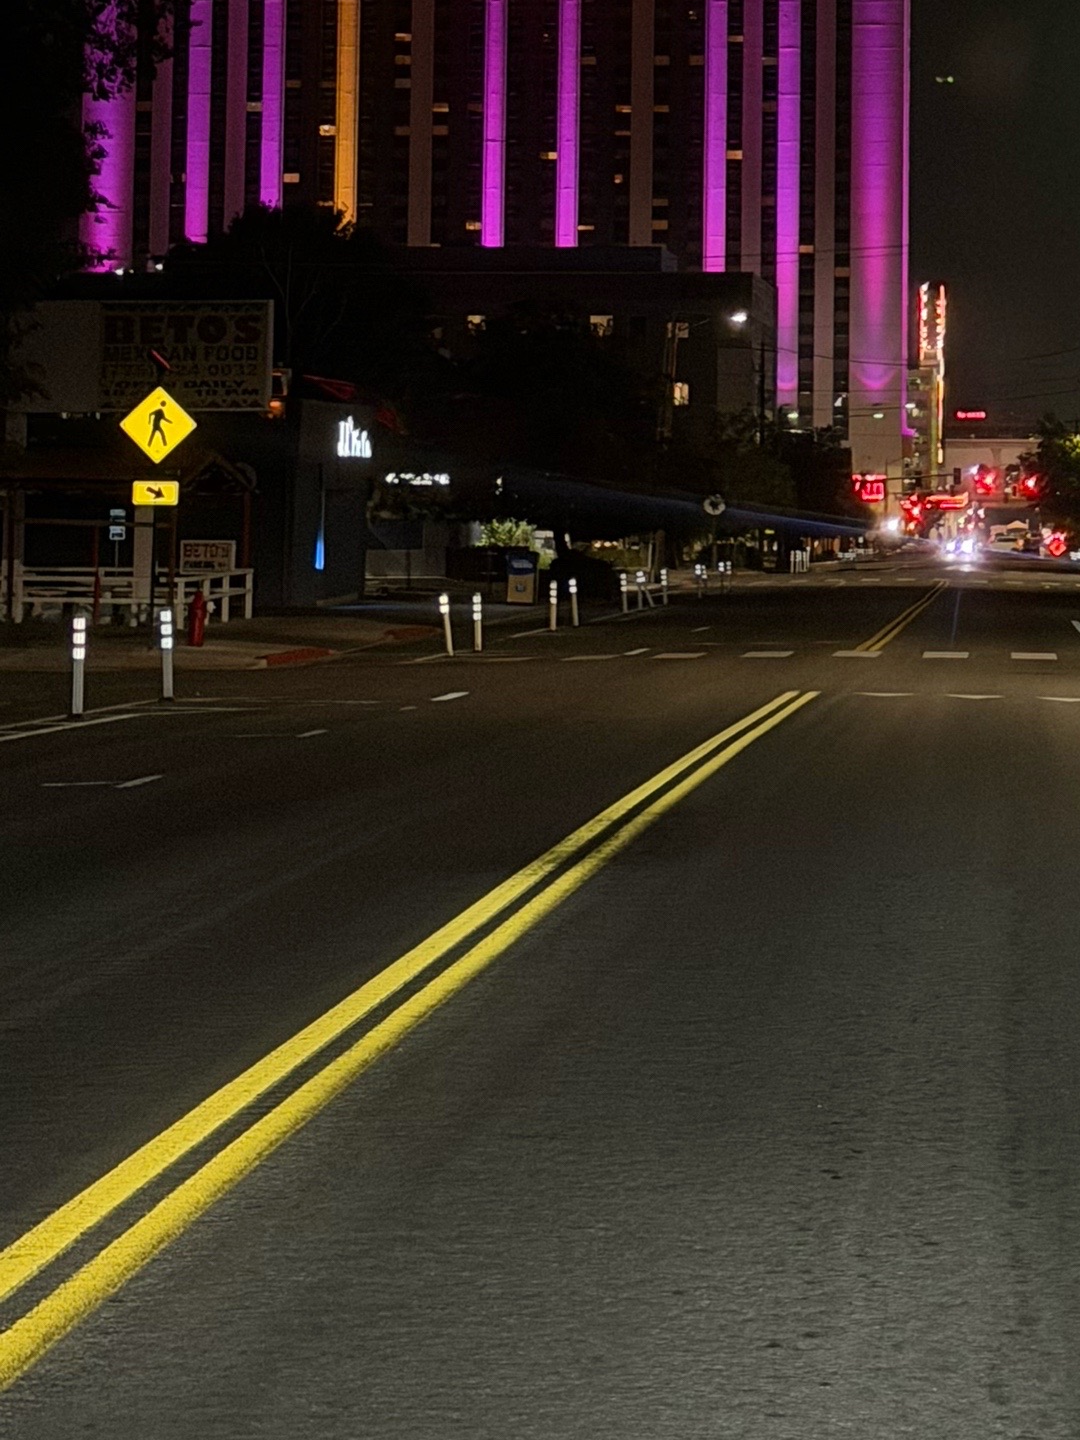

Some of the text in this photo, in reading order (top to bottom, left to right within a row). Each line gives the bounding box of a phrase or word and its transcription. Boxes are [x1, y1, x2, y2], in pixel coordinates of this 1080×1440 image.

[104, 315, 261, 344] BETO'S
[103, 346, 258, 361] MEXCAN FOOD
[184, 380, 246, 388] DAILY
